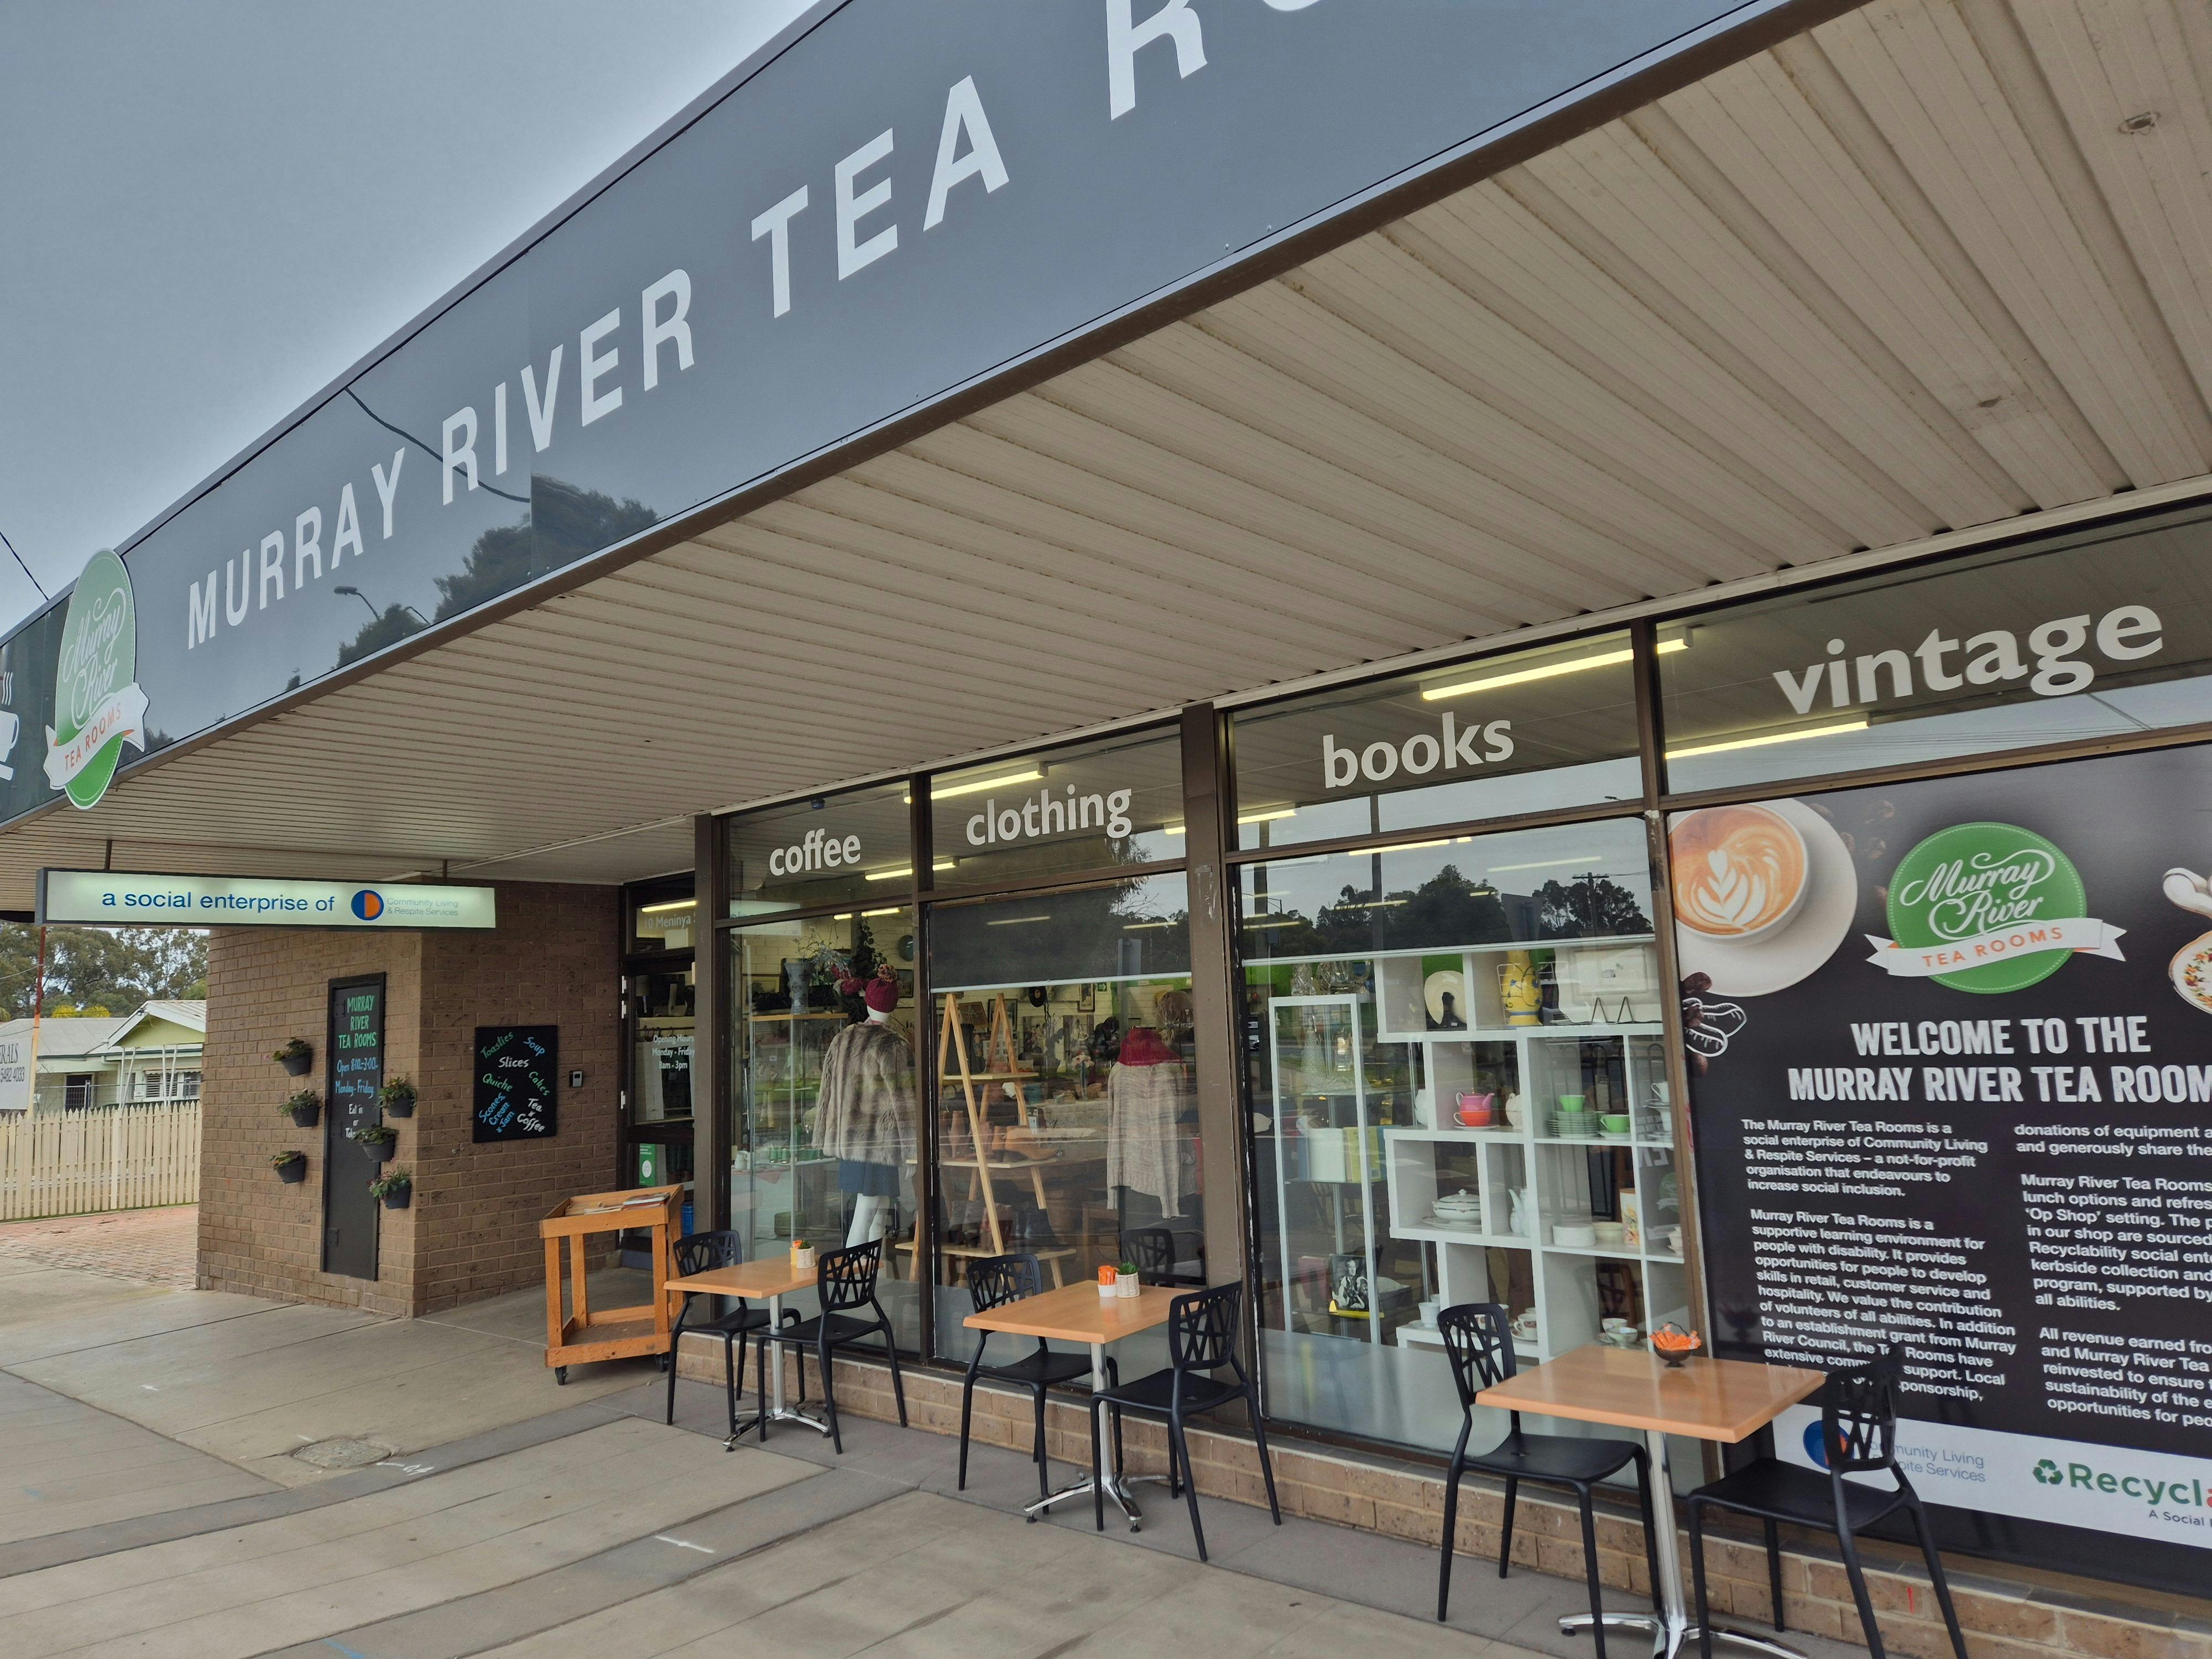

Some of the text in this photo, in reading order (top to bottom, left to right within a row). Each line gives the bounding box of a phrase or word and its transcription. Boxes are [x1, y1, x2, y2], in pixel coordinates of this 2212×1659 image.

[188, 447, 405, 649] MURRAY
[443, 269, 695, 505] RIVER
[752, 75, 1009, 318] TEA
[63, 587, 127, 682] Murray
[1772, 605, 2163, 714] vintage
[71, 654, 118, 730] River
[64, 702, 122, 771] TEA ROOMS
[1323, 712, 1514, 789] books
[967, 785, 1132, 846] clothing
[769, 828, 861, 877] coffee
[1900, 849, 2056, 906] Murray
[102, 891, 335, 914] a social enterprise of
[387, 898, 458, 909] Community Living
[394, 907, 424, 916] Respite
[425, 908, 458, 916] Services
[655, 914, 691, 929] Meninya
[1929, 889, 2045, 940] River
[1922, 927, 2064, 968] TEA ROOMS
[347, 995, 375, 1014] MURRAY
[350, 1015, 369, 1031] RIVER
[338, 1031, 377, 1049] TEA ROOMS
[480, 1031, 514, 1059] Toasties
[653, 1034, 676, 1045] Opening
[1850, 1015, 2152, 1056] WELCOME TO THE
[0, 1043, 18, 1064] RALS
[523, 1036, 546, 1057] Soup
[651, 1047, 674, 1058] Monday
[677, 1046, 695, 1057] Friday
[337, 1059, 349, 1078] Open
[498, 1056, 530, 1068] Slices
[658, 1061, 671, 1070] 8am
[675, 1060, 688, 1071] 3pm
[482, 1073, 513, 1092] Quiche
[528, 1071, 550, 1096] Cakes
[1787, 1065, 2212, 1103] MURRAY RIVER TEA ROOM
[348, 1103, 357, 1114] Eat
[488, 1102, 512, 1125] Cream
[528, 1098, 543, 1112] Tea
[499, 1111, 516, 1128] Jam
[517, 1113, 546, 1133] Coffee
[1741, 1119, 1952, 1133] The Murray River Tea Rooms is a
[2014, 1124, 2090, 1135] donations
[2094, 1125, 2109, 1136] of
[2114, 1125, 2200, 1139] equipment
[1743, 1135, 1987, 1153] social enterprise of Community Living
[2016, 1141, 2045, 1152] and
[2049, 1142, 2133, 1156] generously
[2138, 1143, 2183, 1155] share
[1744, 1149, 1754, 1159] &
[1756, 1149, 1803, 1162] Respite
[1806, 1151, 1861, 1162] Services
[1886, 1154, 1976, 1167] not-for-profit
[1746, 1165, 1950, 1182] organisation that endeavours to
[2021, 1174, 2074, 1189] Murray
[2078, 1176, 2119, 1188] River
[2121, 1177, 2151, 1189] Tea
[1747, 1178, 1905, 1196] increase social inclusion.
[1750, 1209, 1934, 1230] Murray River Tea Rooms is a
[1752, 1226, 1985, 1249] supportive learning environment for
[1754, 1241, 1966, 1264] people with disability. It provides
[1755, 1256, 1986, 1285] opportunities for people to develop
[2031, 1259, 2097, 1274] kerbside
[2101, 1264, 2178, 1279] collection
[1756, 1270, 1990, 1300] skills in retail, customer service and
[2035, 1293, 2120, 1310] all abilities.
[2041, 1347, 2209, 1371] and Murray River Tea
[2043, 1363, 2204, 1389] reinvested to ensure
[1942, 1449, 1985, 1469] Living
[1926, 1463, 1986, 1483] Services
[2149, 1509, 2158, 1519] A
[2163, 1511, 2205, 1526] Social
